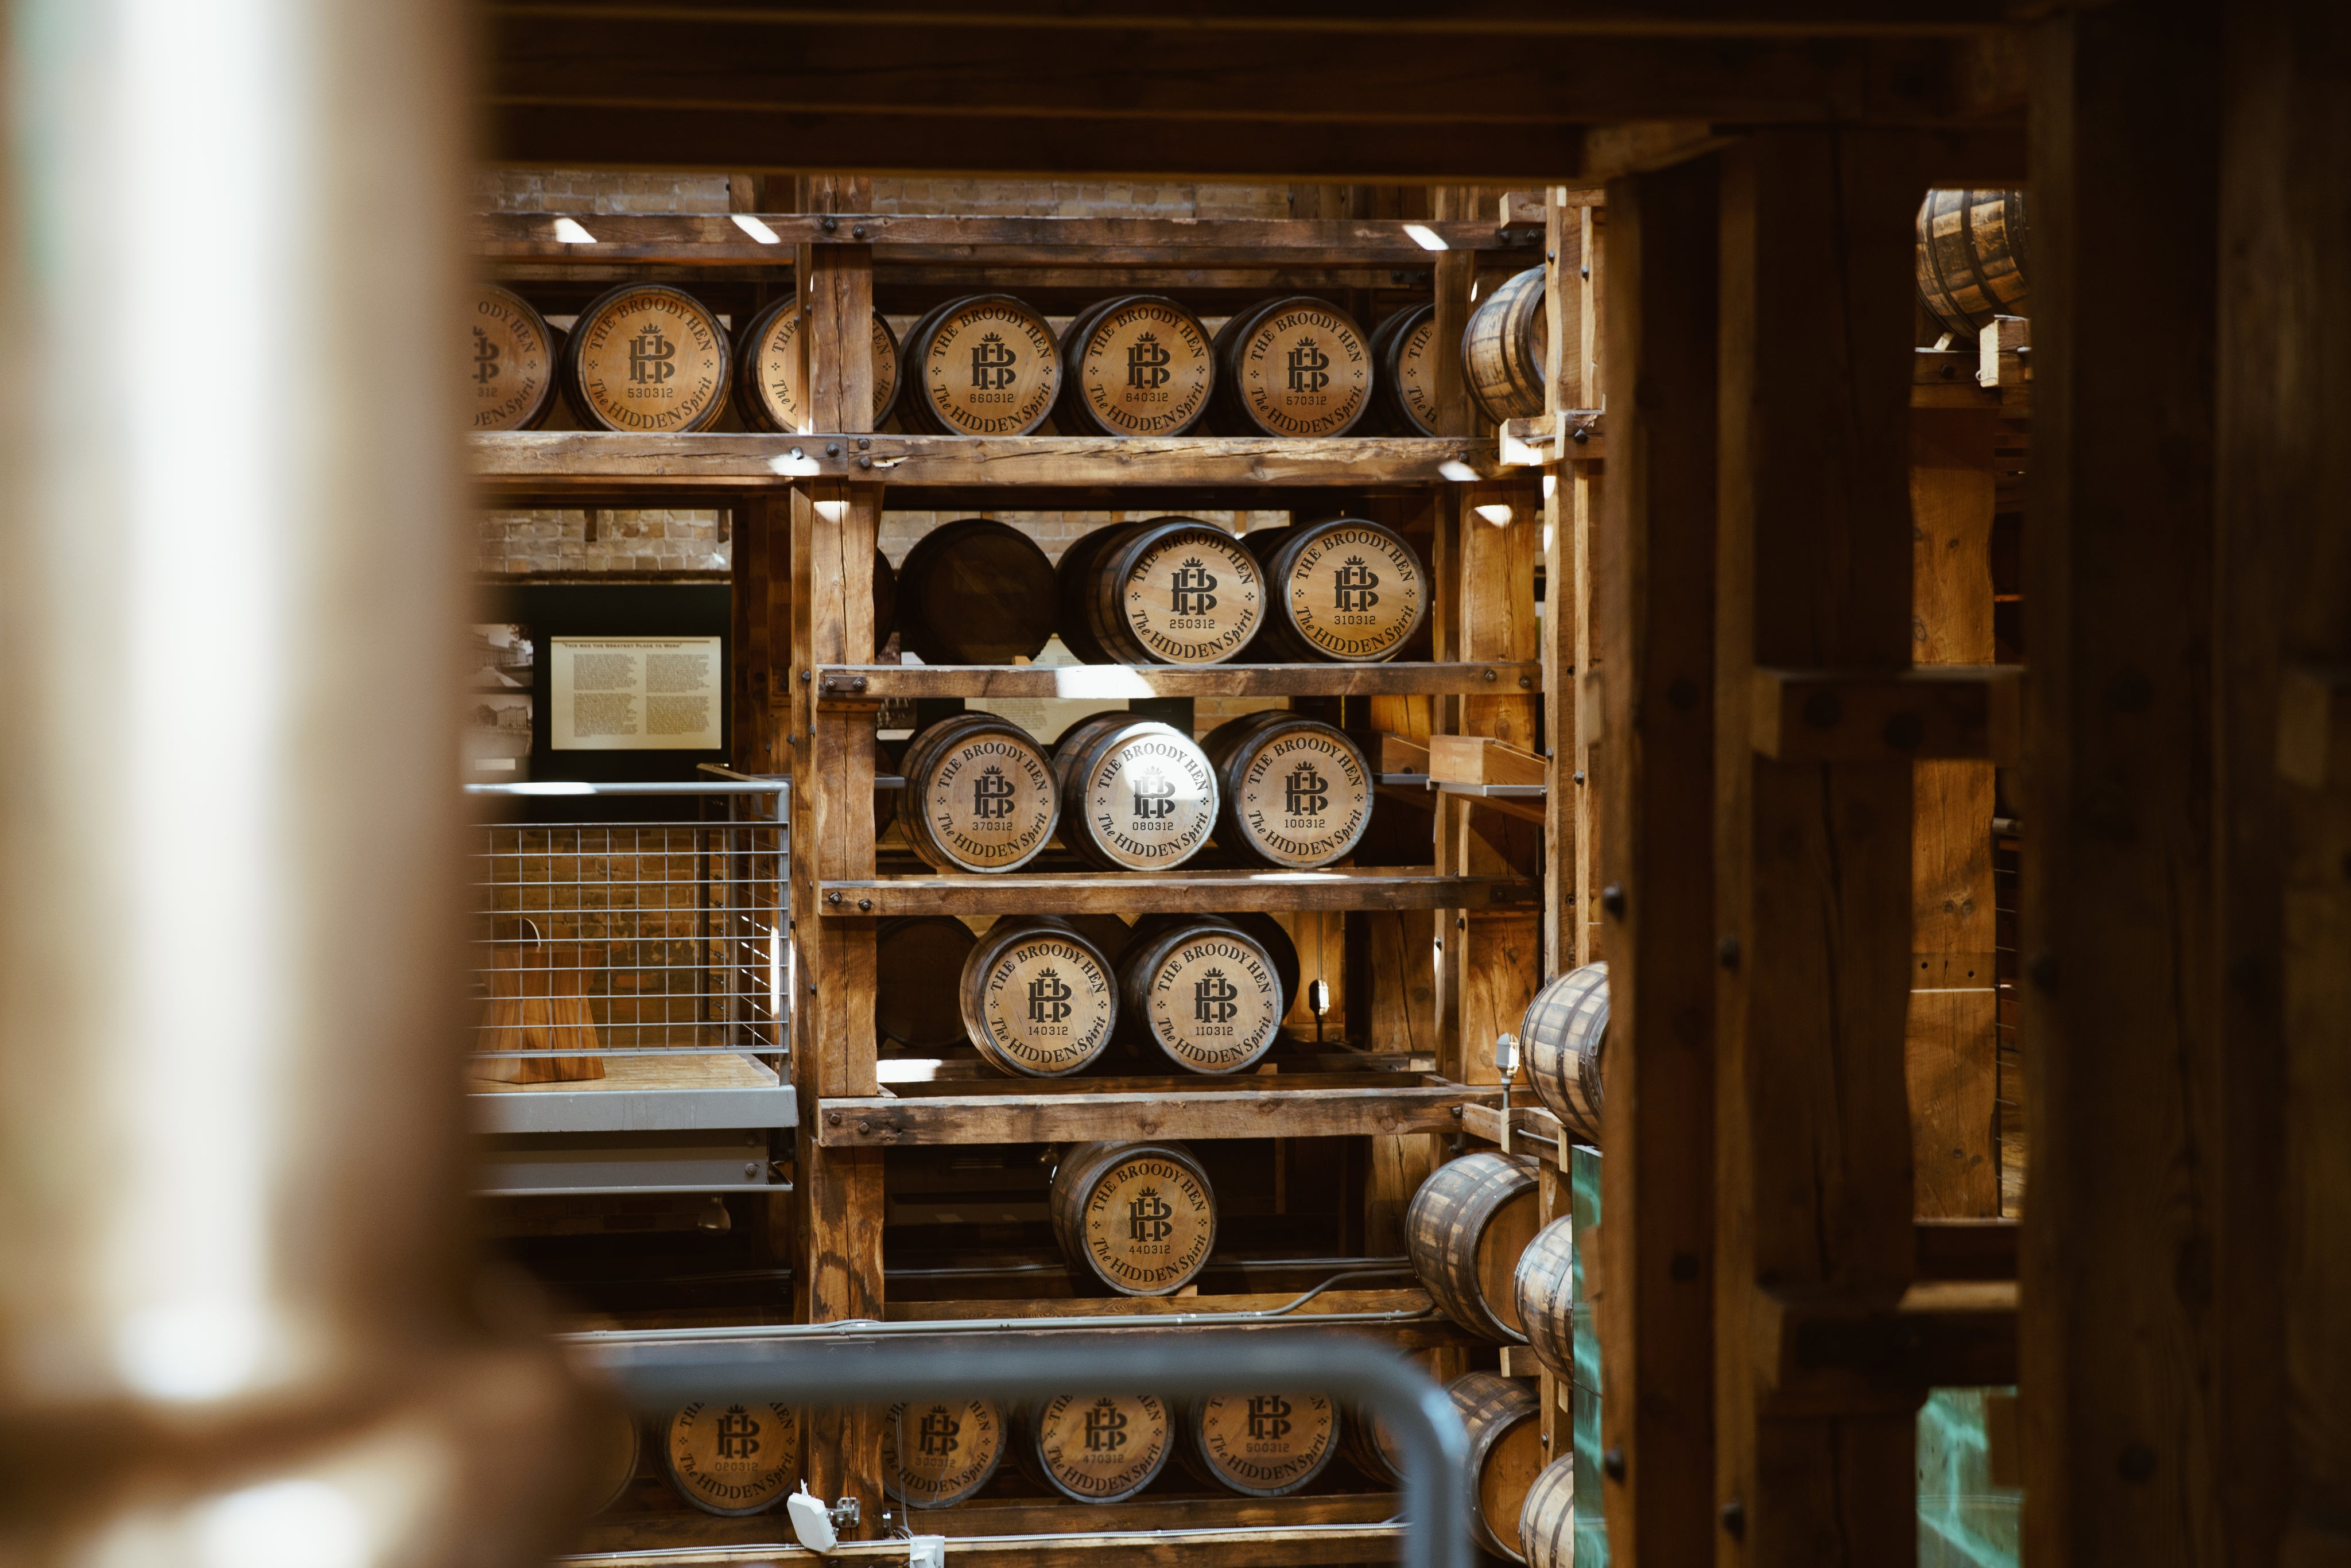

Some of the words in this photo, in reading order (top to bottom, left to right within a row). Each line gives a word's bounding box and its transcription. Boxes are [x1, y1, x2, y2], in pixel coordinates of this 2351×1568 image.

[478, 301, 513, 322] ODY
[510, 319, 536, 354] HEN
[589, 317, 615, 350] THE
[616, 297, 690, 320] BROODY
[685, 316, 712, 351] HEN
[771, 321, 800, 353] THE
[933, 325, 958, 358] THE
[959, 307, 1029, 328] BROODY
[1025, 325, 1051, 359] HEN
[1091, 325, 1115, 357] THE
[1115, 307, 1182, 328] BROODY
[1180, 325, 1204, 358] HEN
[1251, 329, 1275, 360] THE
[1275, 312, 1341, 333] BROODY
[1338, 329, 1362, 362] HEN
[1408, 327, 1433, 358] THE
[478, 387, 497, 397] 312
[506, 377, 536, 414] Spirit
[590, 379, 608, 405] The
[607, 401, 682, 429] HIDDEN
[681, 377, 712, 416] Spirit
[628, 388, 673, 398] 530312
[772, 380, 790, 405] The
[873, 378, 890, 412] pirit
[933, 384, 951, 409] The
[949, 406, 1022, 432] HIDDEN
[1022, 382, 1050, 420] Spirit
[970, 394, 1014, 402] 660312
[1090, 384, 1108, 409] The
[1106, 405, 1177, 431] HIDDEN
[1176, 382, 1204, 418] Spirit
[1126, 393, 1168, 402] 640312
[1251, 387, 1268, 412] The
[1267, 407, 1335, 433] HIDDEN
[1334, 385, 1362, 422] Spirit
[1287, 396, 1326, 405] 570312
[1408, 386, 1426, 410] The
[1132, 550, 1159, 583] THE
[1159, 533, 1230, 554] BROODY
[1228, 550, 1254, 584] HEN
[1295, 548, 1321, 580] THE
[1321, 531, 1392, 552] BROODY
[1388, 548, 1414, 582] HEN
[1132, 610, 1150, 635] The
[1149, 631, 1224, 658] HIDDEN
[1223, 609, 1254, 646] Spirit
[1170, 619, 1215, 628] 250312
[1296, 606, 1314, 631] The
[1313, 627, 1385, 653] HIDDEN
[1385, 605, 1414, 642] Spirit
[1334, 616, 1375, 624] 310312
[938, 758, 962, 788] THE
[962, 743, 1027, 763] BROODY
[1024, 759, 1048, 790] HEN
[1098, 759, 1122, 789] THE
[1122, 743, 1188, 763] BROODY
[1184, 759, 1208, 791] HEN
[1248, 754, 1273, 785] THE
[1273, 738, 1341, 758] BROODY
[1337, 754, 1363, 787] HEN
[938, 813, 955, 836] The
[953, 833, 1021, 857] HIDDEN
[1020, 812, 1047, 847] Spirit
[972, 822, 1012, 830] 370312
[1098, 813, 1115, 836] The
[1114, 833, 1181, 857] HIDDEN
[1181, 812, 1208, 847] Spirit
[1132, 822, 1173, 830] 080312
[1248, 810, 1266, 834] The
[1264, 830, 1334, 855] HIDDEN
[1334, 809, 1362, 844] Spirit
[1285, 819, 1325, 828] 100312
[991, 960, 1016, 991] THE
[1015, 944, 1084, 964] BROODY
[1081, 960, 1106, 993] HEN
[1157, 960, 1182, 991] THE
[1182, 944, 1250, 964] BROODY
[1247, 960, 1271, 993] HEN
[991, 1017, 1009, 1041] The
[1007, 1037, 1078, 1063] HIDDEN
[1077, 1016, 1105, 1052] Spirit
[1029, 1026, 1068, 1035] 140312
[1158, 1018, 1176, 1042] The
[1174, 1038, 1244, 1063] HIDDEN
[1243, 1016, 1271, 1052] Spirit
[1196, 1027, 1233, 1035] 110312
[1092, 1181, 1116, 1212] THE
[1116, 1163, 1184, 1183] BROODY
[1180, 1179, 1205, 1212] HEN
[1093, 1237, 1111, 1262] The
[1109, 1257, 1180, 1282] HIDDEN
[1179, 1235, 1206, 1270] Spirit
[1129, 1245, 1170, 1254] 440312
[969, 1400, 991, 1431] HEN
[884, 1448, 898, 1470] The
[897, 1468, 962, 1492] HIDDEN
[961, 1452, 988, 1483] Spirit
[1048, 1446, 1064, 1469] The
[1063, 1466, 1132, 1491] HIDDEN
[1131, 1443, 1161, 1478] Spirit
[1084, 1454, 1124, 1464] 470312
[1211, 1434, 1228, 1458] The
[1227, 1454, 1298, 1480] HIDDEN
[1298, 1433, 1326, 1468] Spirit
[1247, 1443, 1289, 1452] 500312
[680, 1453, 698, 1477] The
[696, 1473, 766, 1499] HIDDEN
[766, 1452, 794, 1484] Spirit
